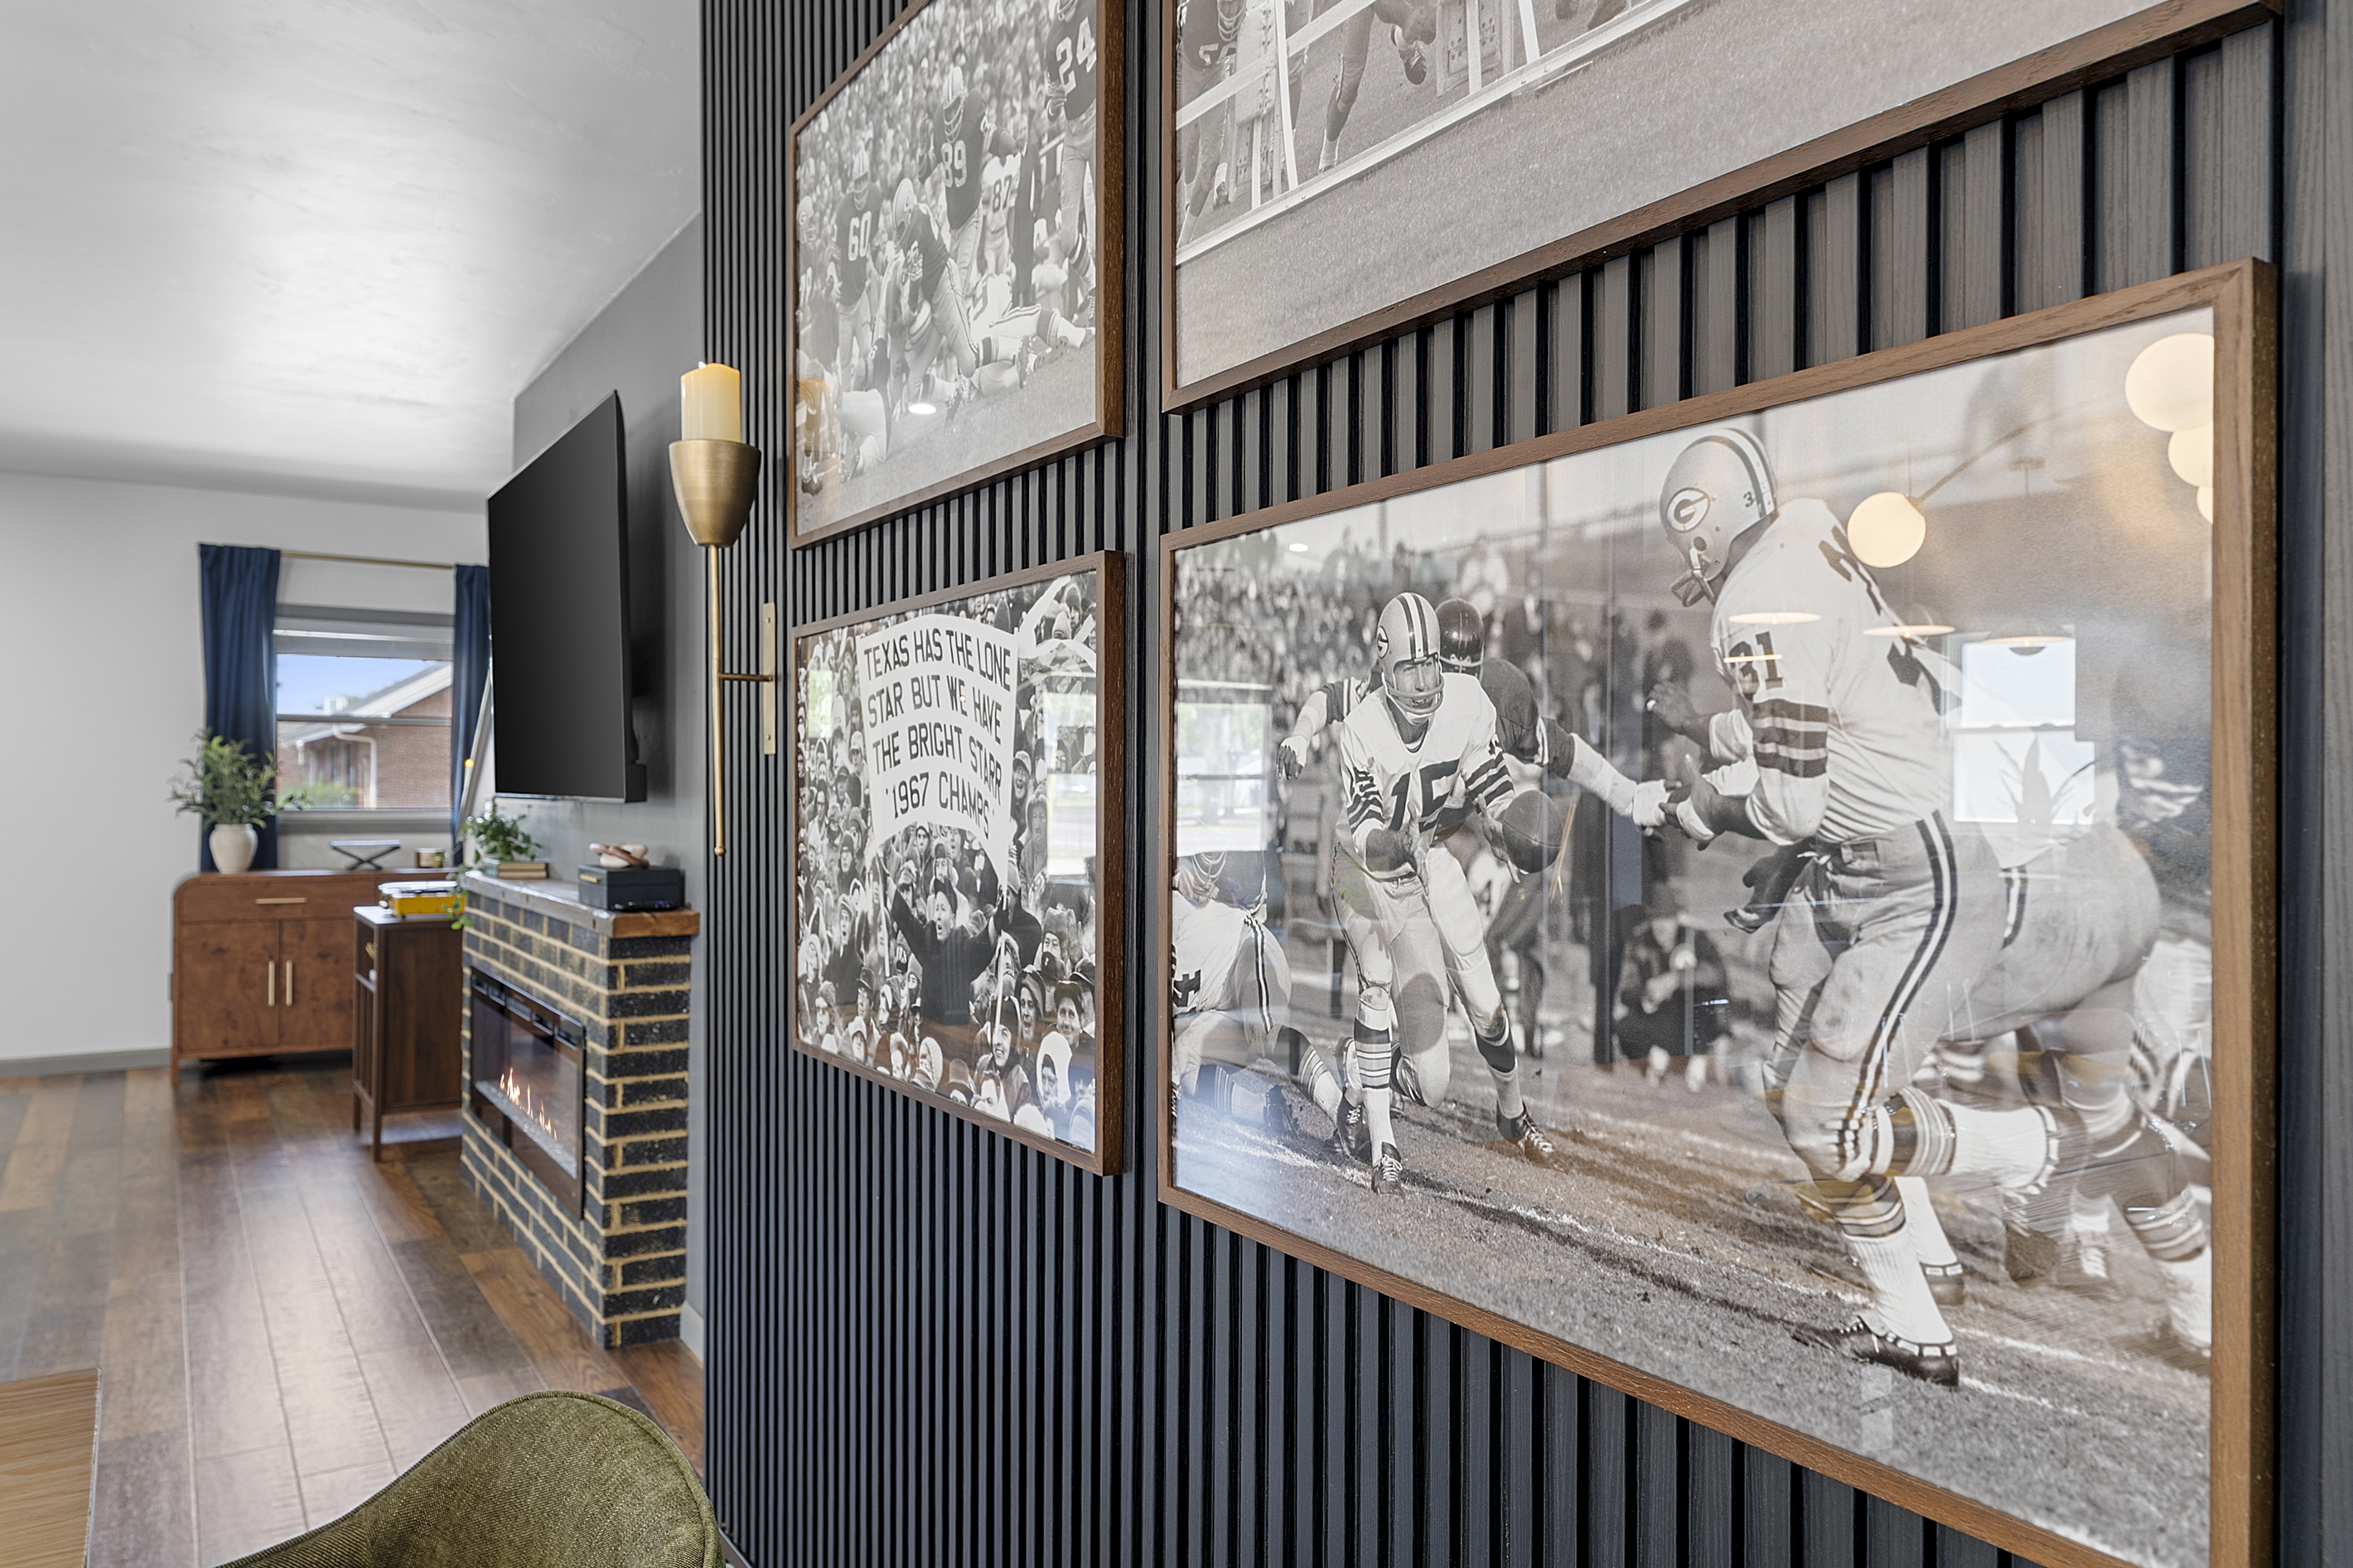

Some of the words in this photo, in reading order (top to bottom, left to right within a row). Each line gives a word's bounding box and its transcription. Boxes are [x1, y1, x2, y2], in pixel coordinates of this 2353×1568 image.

[1056, 17, 1097, 95] 24
[941, 140, 968, 188] 89
[992, 174, 1012, 212] 87
[848, 210, 872, 262] 60
[1666, 486, 1711, 533] G
[863, 634, 910, 681] TEXAS
[914, 628, 943, 663] HAS
[945, 630, 974, 672] THE
[977, 637, 1011, 692] LONE
[867, 682, 905, 728] STAR
[911, 674, 940, 710] BUT
[946, 675, 968, 717] WE
[972, 686, 1002, 745] HAVE
[872, 731, 901, 774] THE
[908, 721, 963, 764] BRIGHT
[969, 736, 1003, 806] STARR
[1388, 758, 1461, 833] 15
